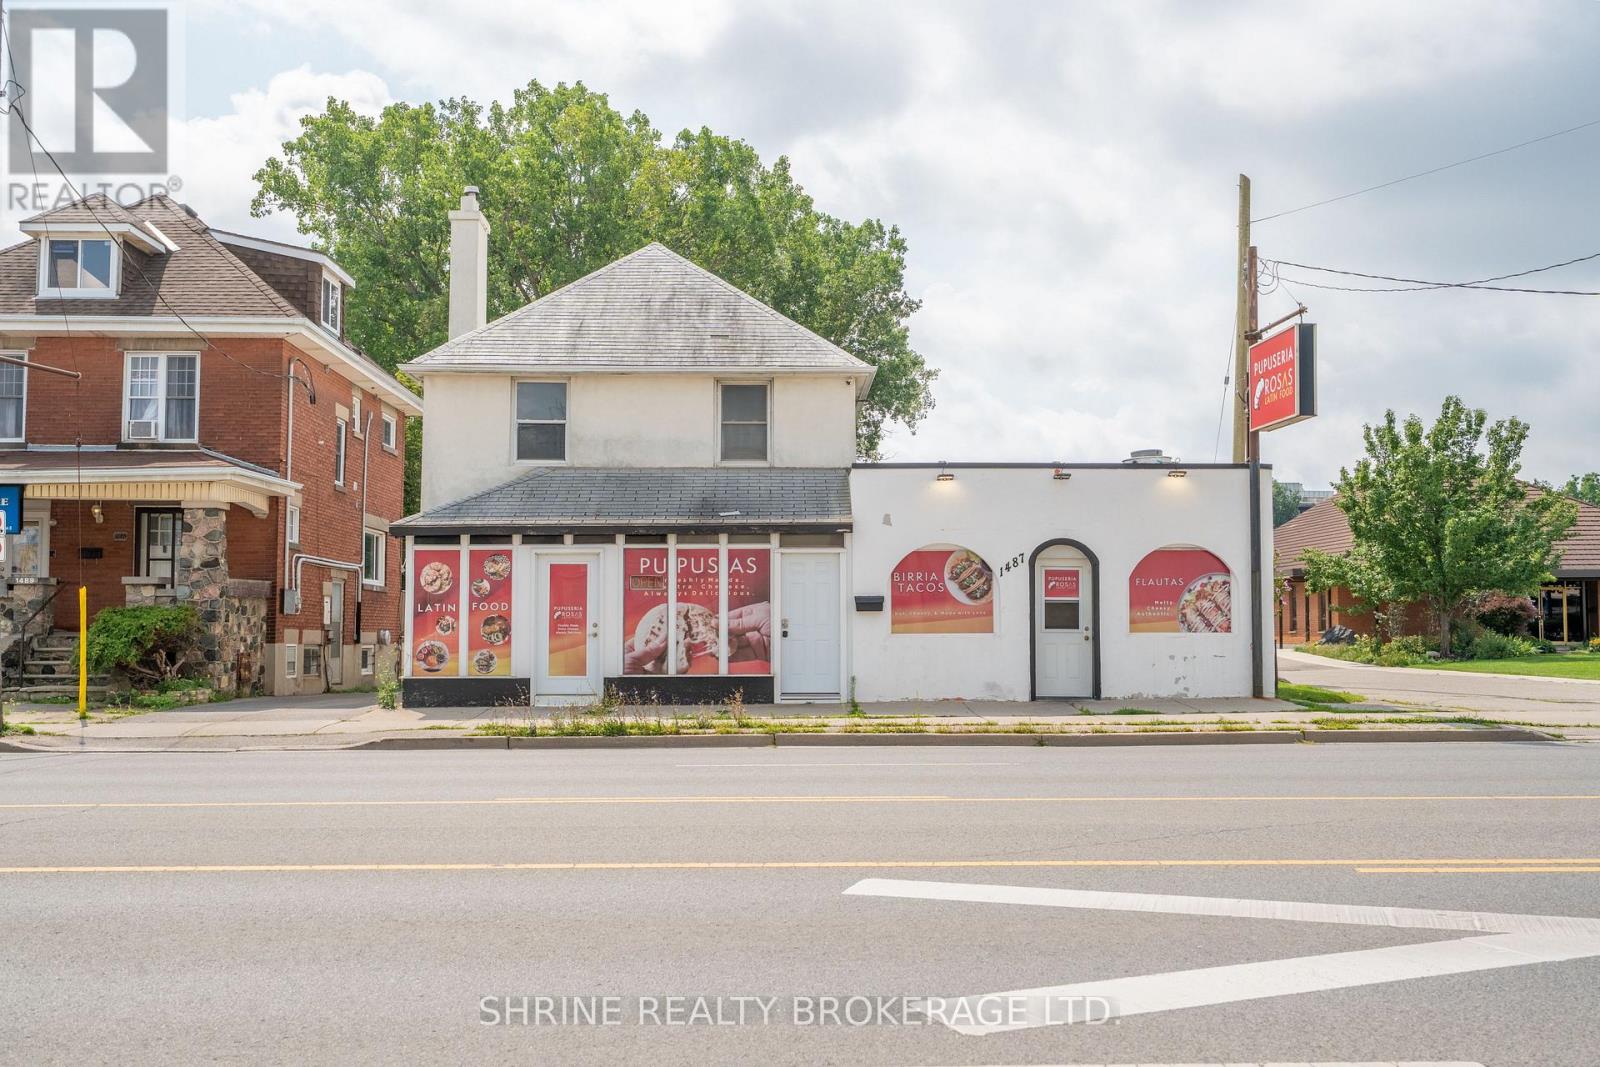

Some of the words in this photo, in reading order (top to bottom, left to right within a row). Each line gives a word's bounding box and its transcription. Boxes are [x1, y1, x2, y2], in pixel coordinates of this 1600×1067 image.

[1254, 345, 1293, 376] PUPUSERIA
[1264, 368, 1293, 395] ROSAS
[999, 552, 1025, 578] 1487
[893, 572, 938, 582] BIRRIA
[1135, 577, 1184, 586] FLAUTAS
[898, 582, 945, 593] TACOS
[417, 603, 456, 612] LATIN
[472, 602, 509, 611] FOOD
